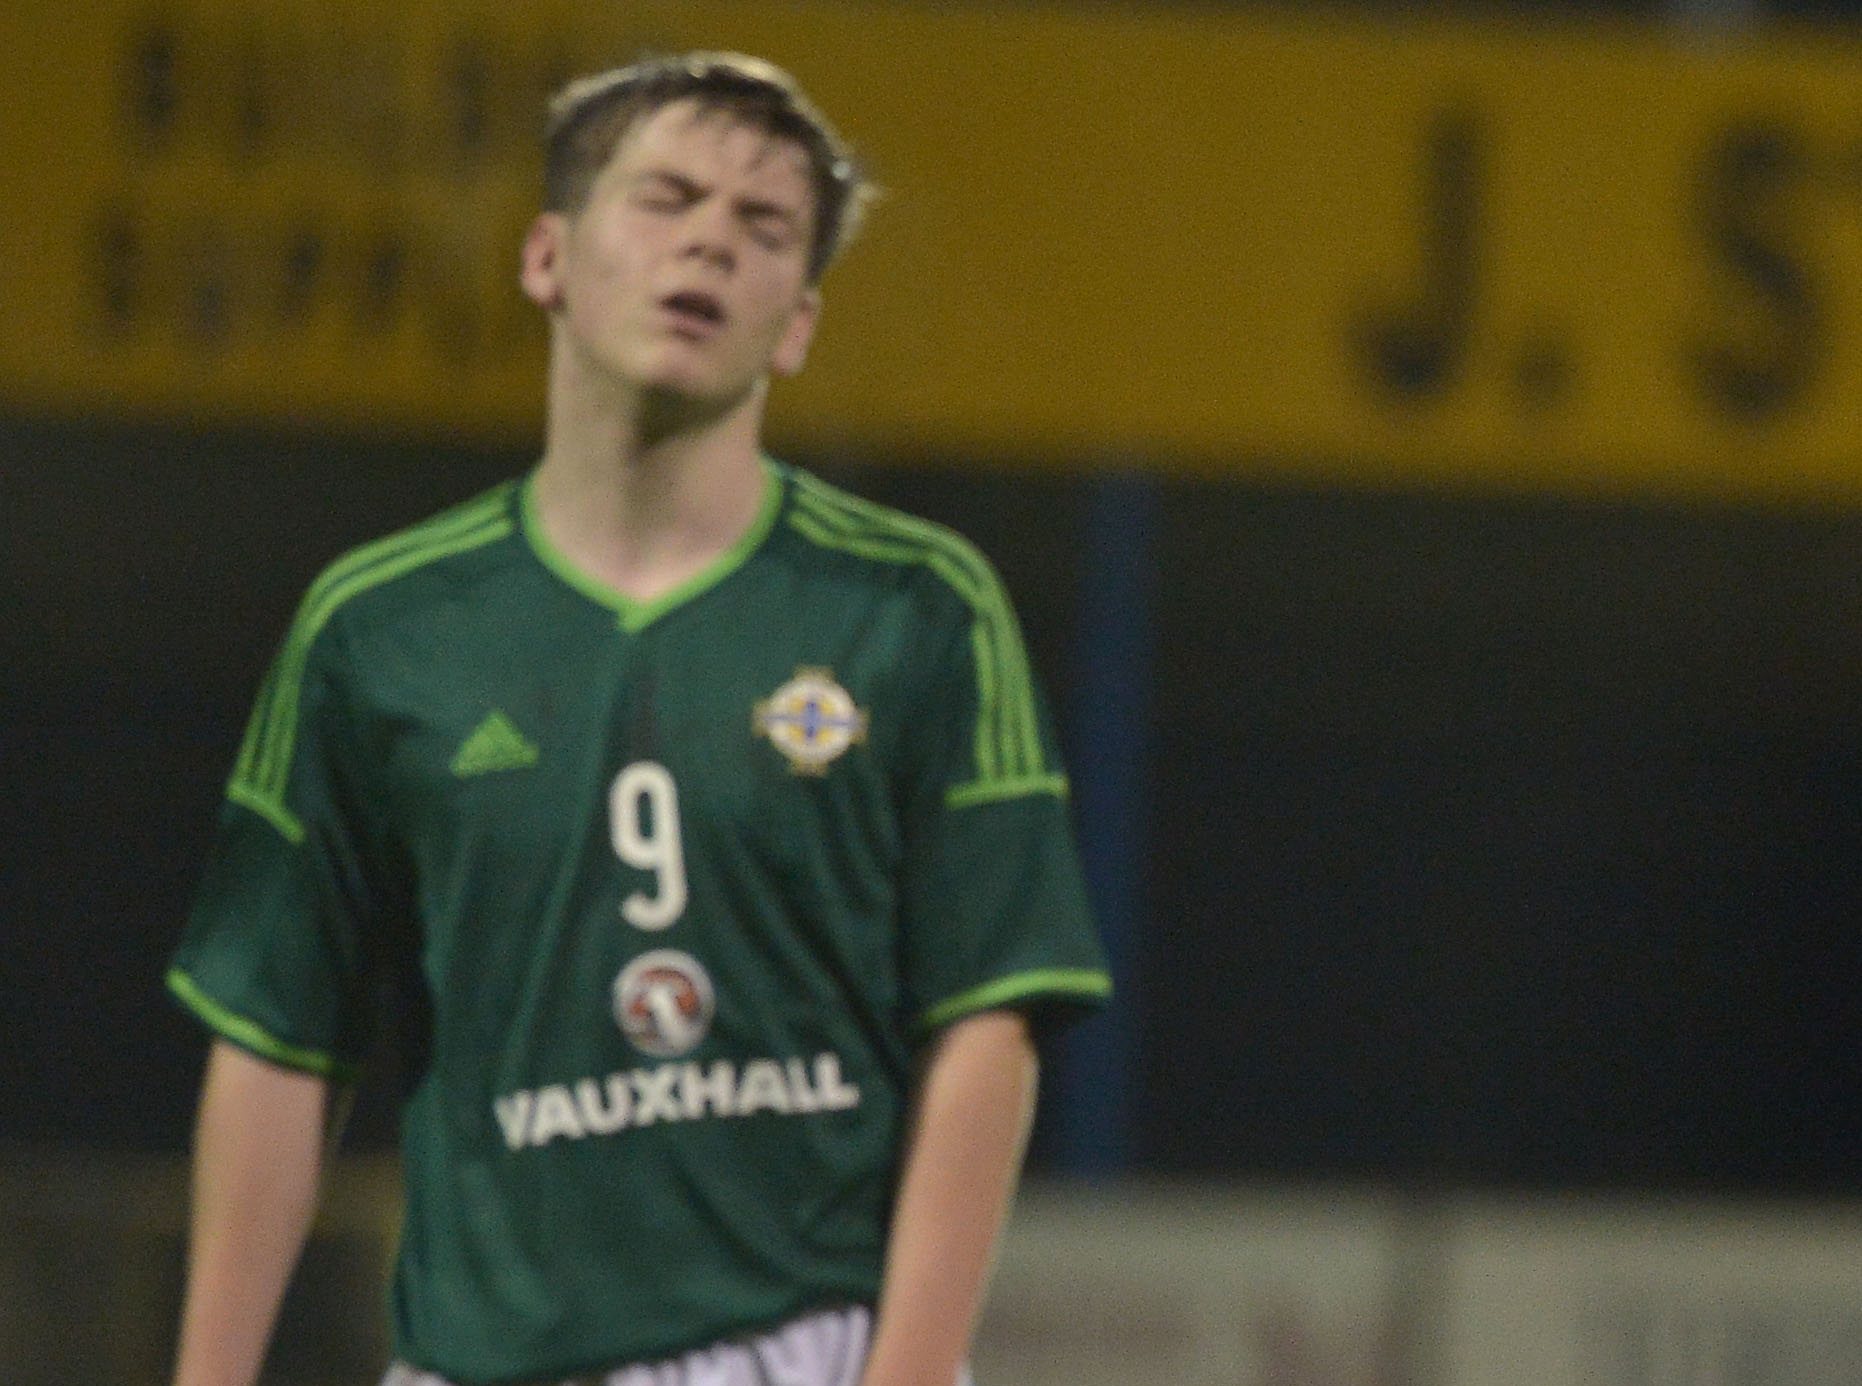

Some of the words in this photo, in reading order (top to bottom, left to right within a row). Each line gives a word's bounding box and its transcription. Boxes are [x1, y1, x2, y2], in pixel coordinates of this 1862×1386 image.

[1358, 100, 1576, 402] J.
[609, 760, 687, 931] 9
[495, 1053, 860, 1149] VAUXHALL
